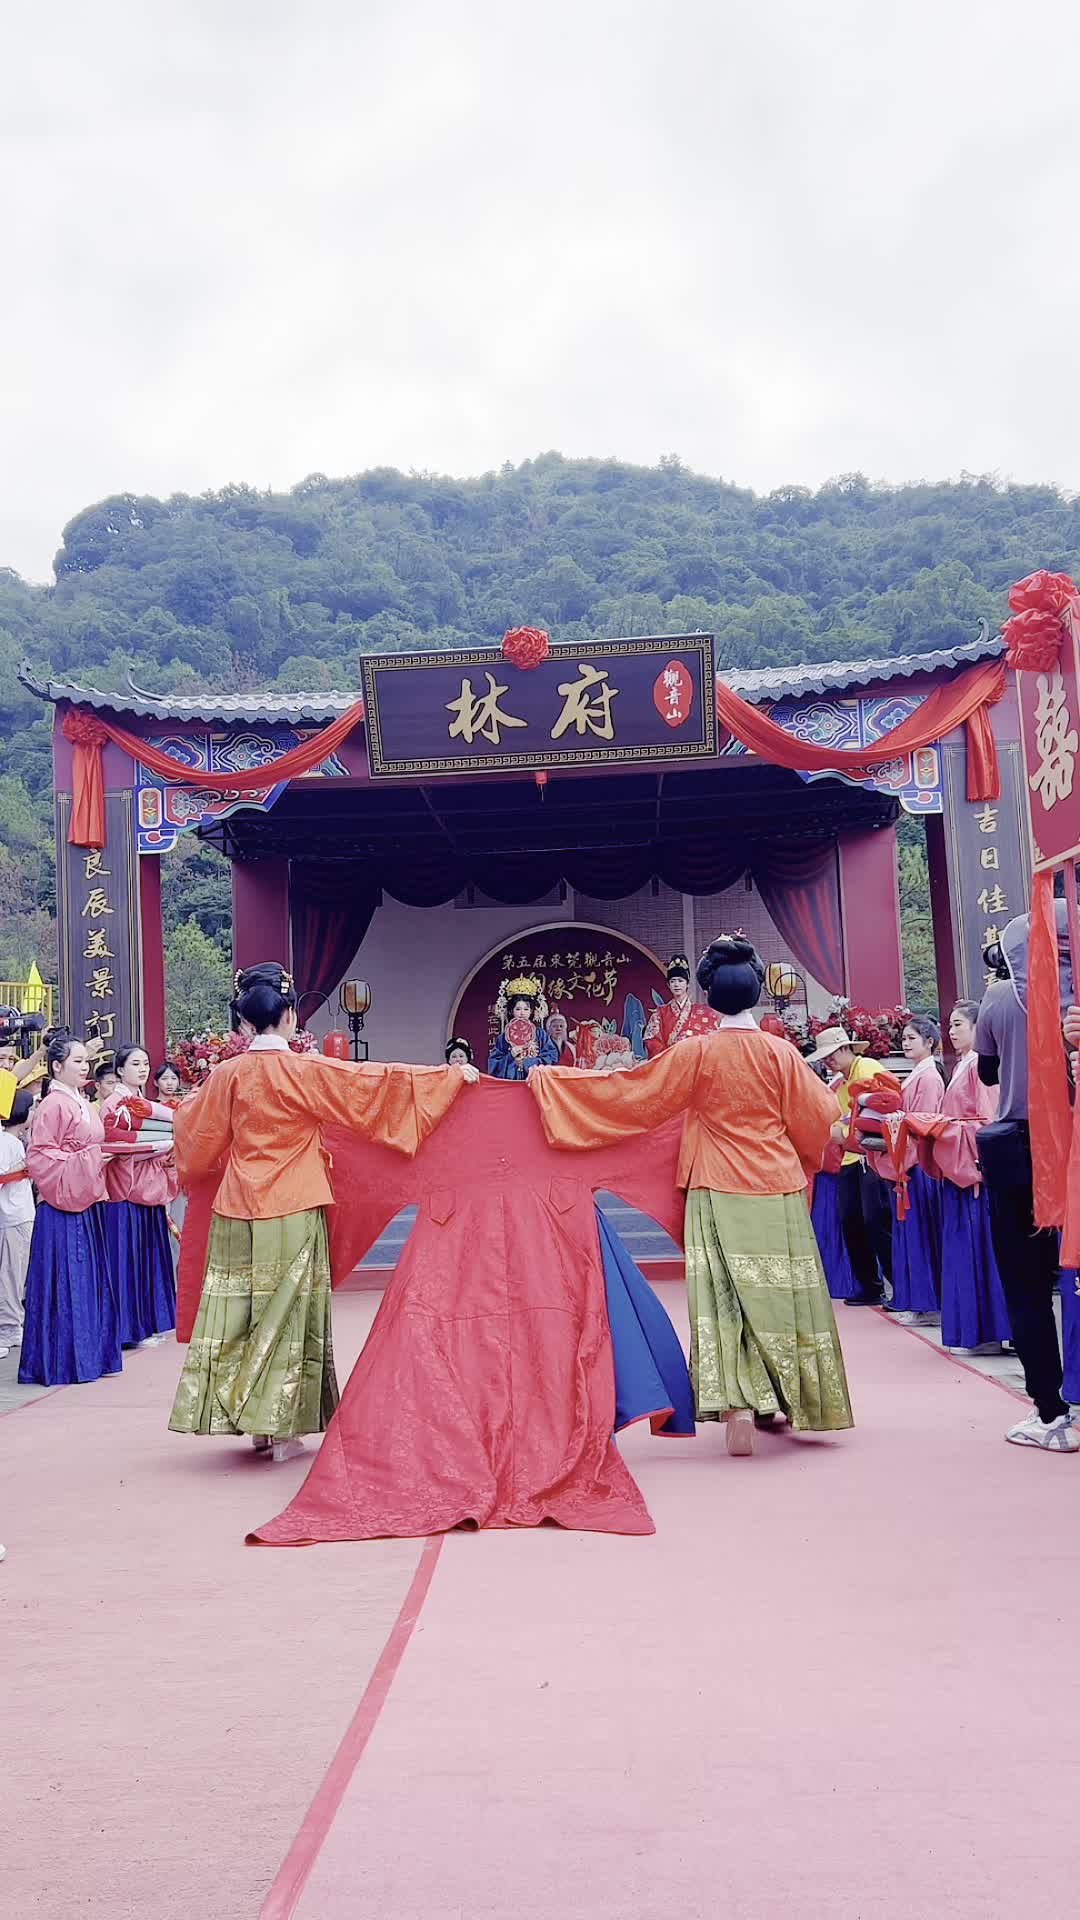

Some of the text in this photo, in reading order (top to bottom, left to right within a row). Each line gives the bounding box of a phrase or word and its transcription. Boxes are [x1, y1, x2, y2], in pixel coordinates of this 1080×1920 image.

[444, 663, 620, 745] 林府
[662, 667, 685, 720] 觀音山
[973, 803, 1009, 991] 吉日佳
[528, 968, 618, 1006] 缘文化节
